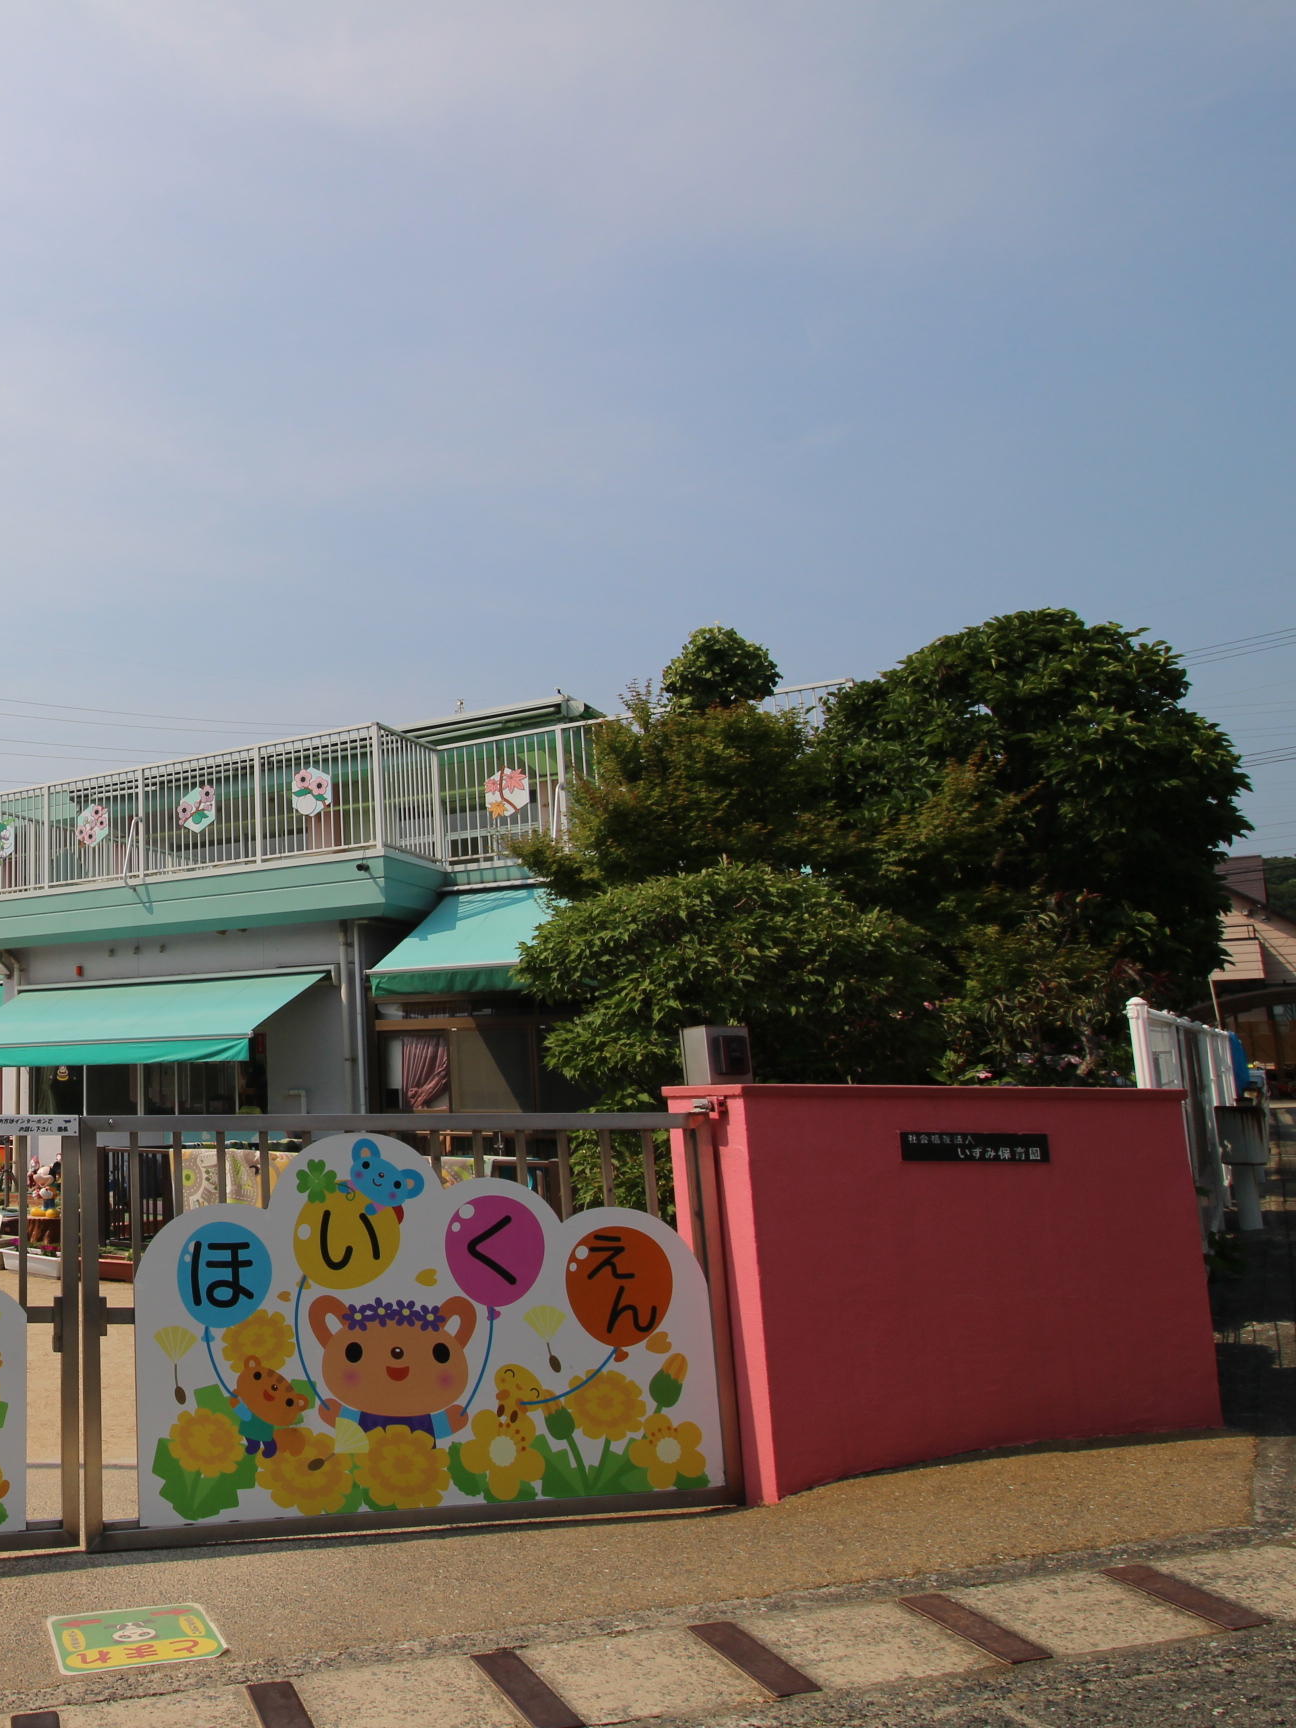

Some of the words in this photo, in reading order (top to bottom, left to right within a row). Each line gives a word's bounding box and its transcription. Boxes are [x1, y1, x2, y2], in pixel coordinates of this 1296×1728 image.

[907, 1134, 975, 1145] 社会福祉法人
[957, 1146, 1041, 1160] いずみ保育園
[76, 1638, 200, 1665] とまれ
